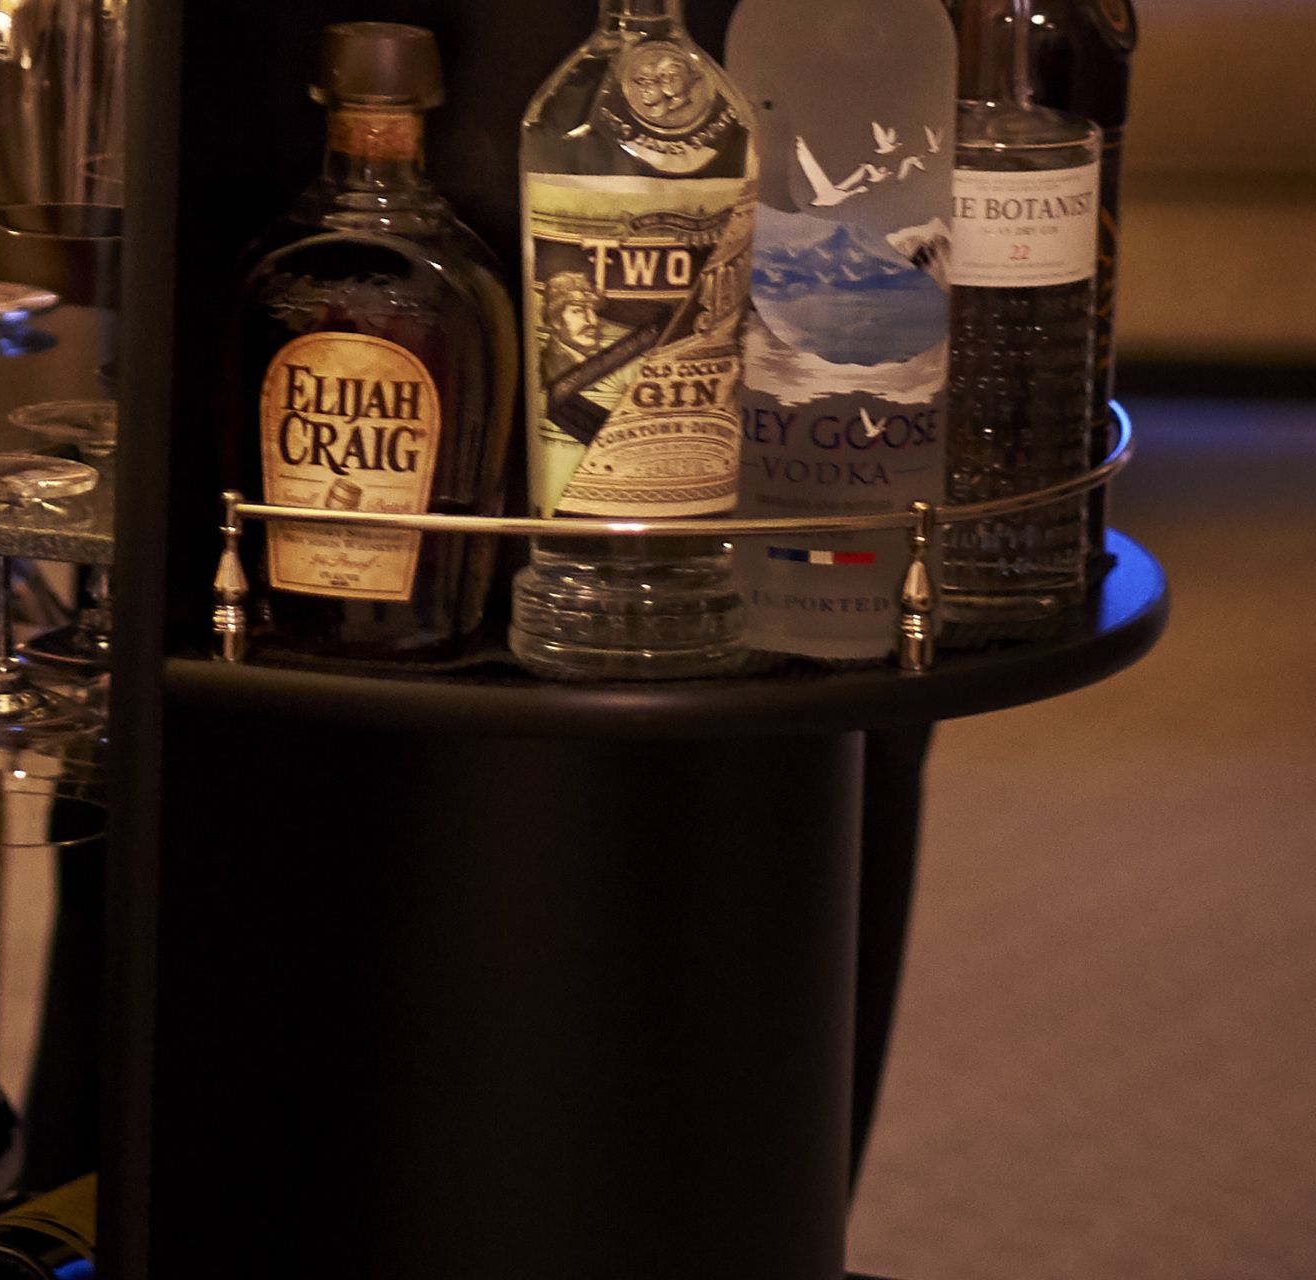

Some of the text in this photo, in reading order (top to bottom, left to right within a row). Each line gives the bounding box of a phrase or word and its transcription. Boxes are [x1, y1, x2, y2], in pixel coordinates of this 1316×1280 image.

[581, 238, 692, 296] TWO
[281, 362, 423, 424] ELIJAH
[633, 377, 721, 409] GIN
[278, 410, 423, 476] CRAIG
[742, 405, 798, 447] REY
[810, 408, 940, 451] GOOSE
[761, 455, 890, 485] VODKA
[750, 589, 890, 613] IPORTED
